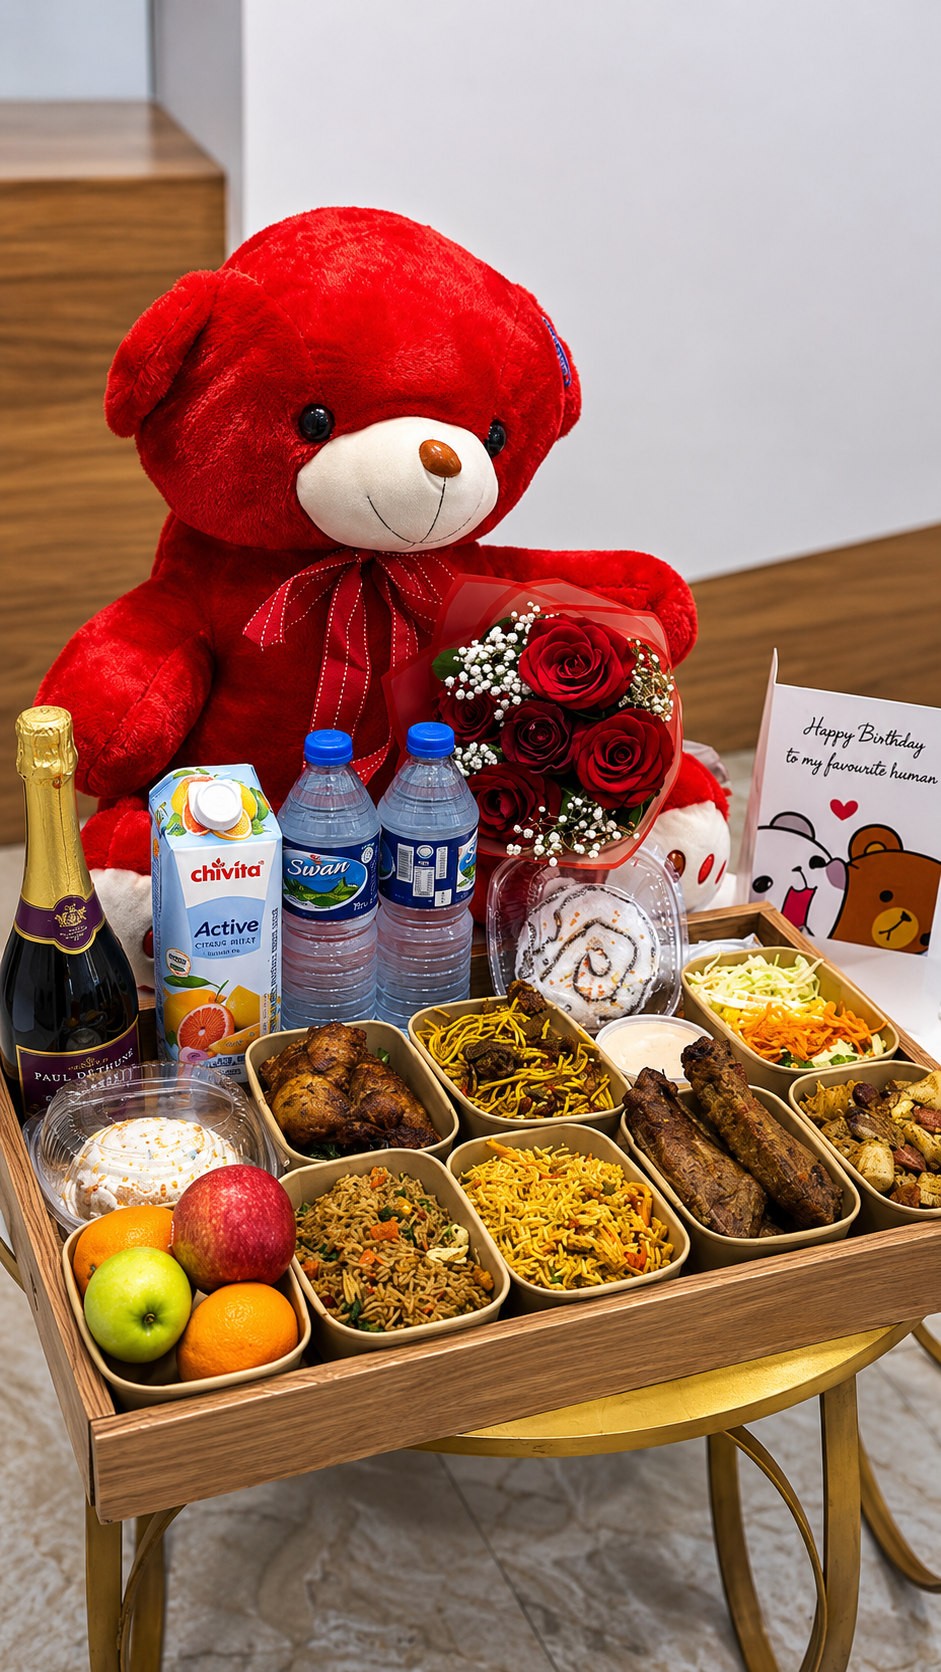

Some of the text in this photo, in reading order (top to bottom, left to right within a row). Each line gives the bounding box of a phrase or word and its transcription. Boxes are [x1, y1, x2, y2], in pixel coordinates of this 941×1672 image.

[803, 716, 926, 759] Happy Birthday
[785, 748, 939, 784] to my favourite human
[190, 857, 261, 883] chivita
[287, 859, 350, 877] Swan
[193, 918, 260, 938] Active
[33, 1071, 72, 1082] PAUL
